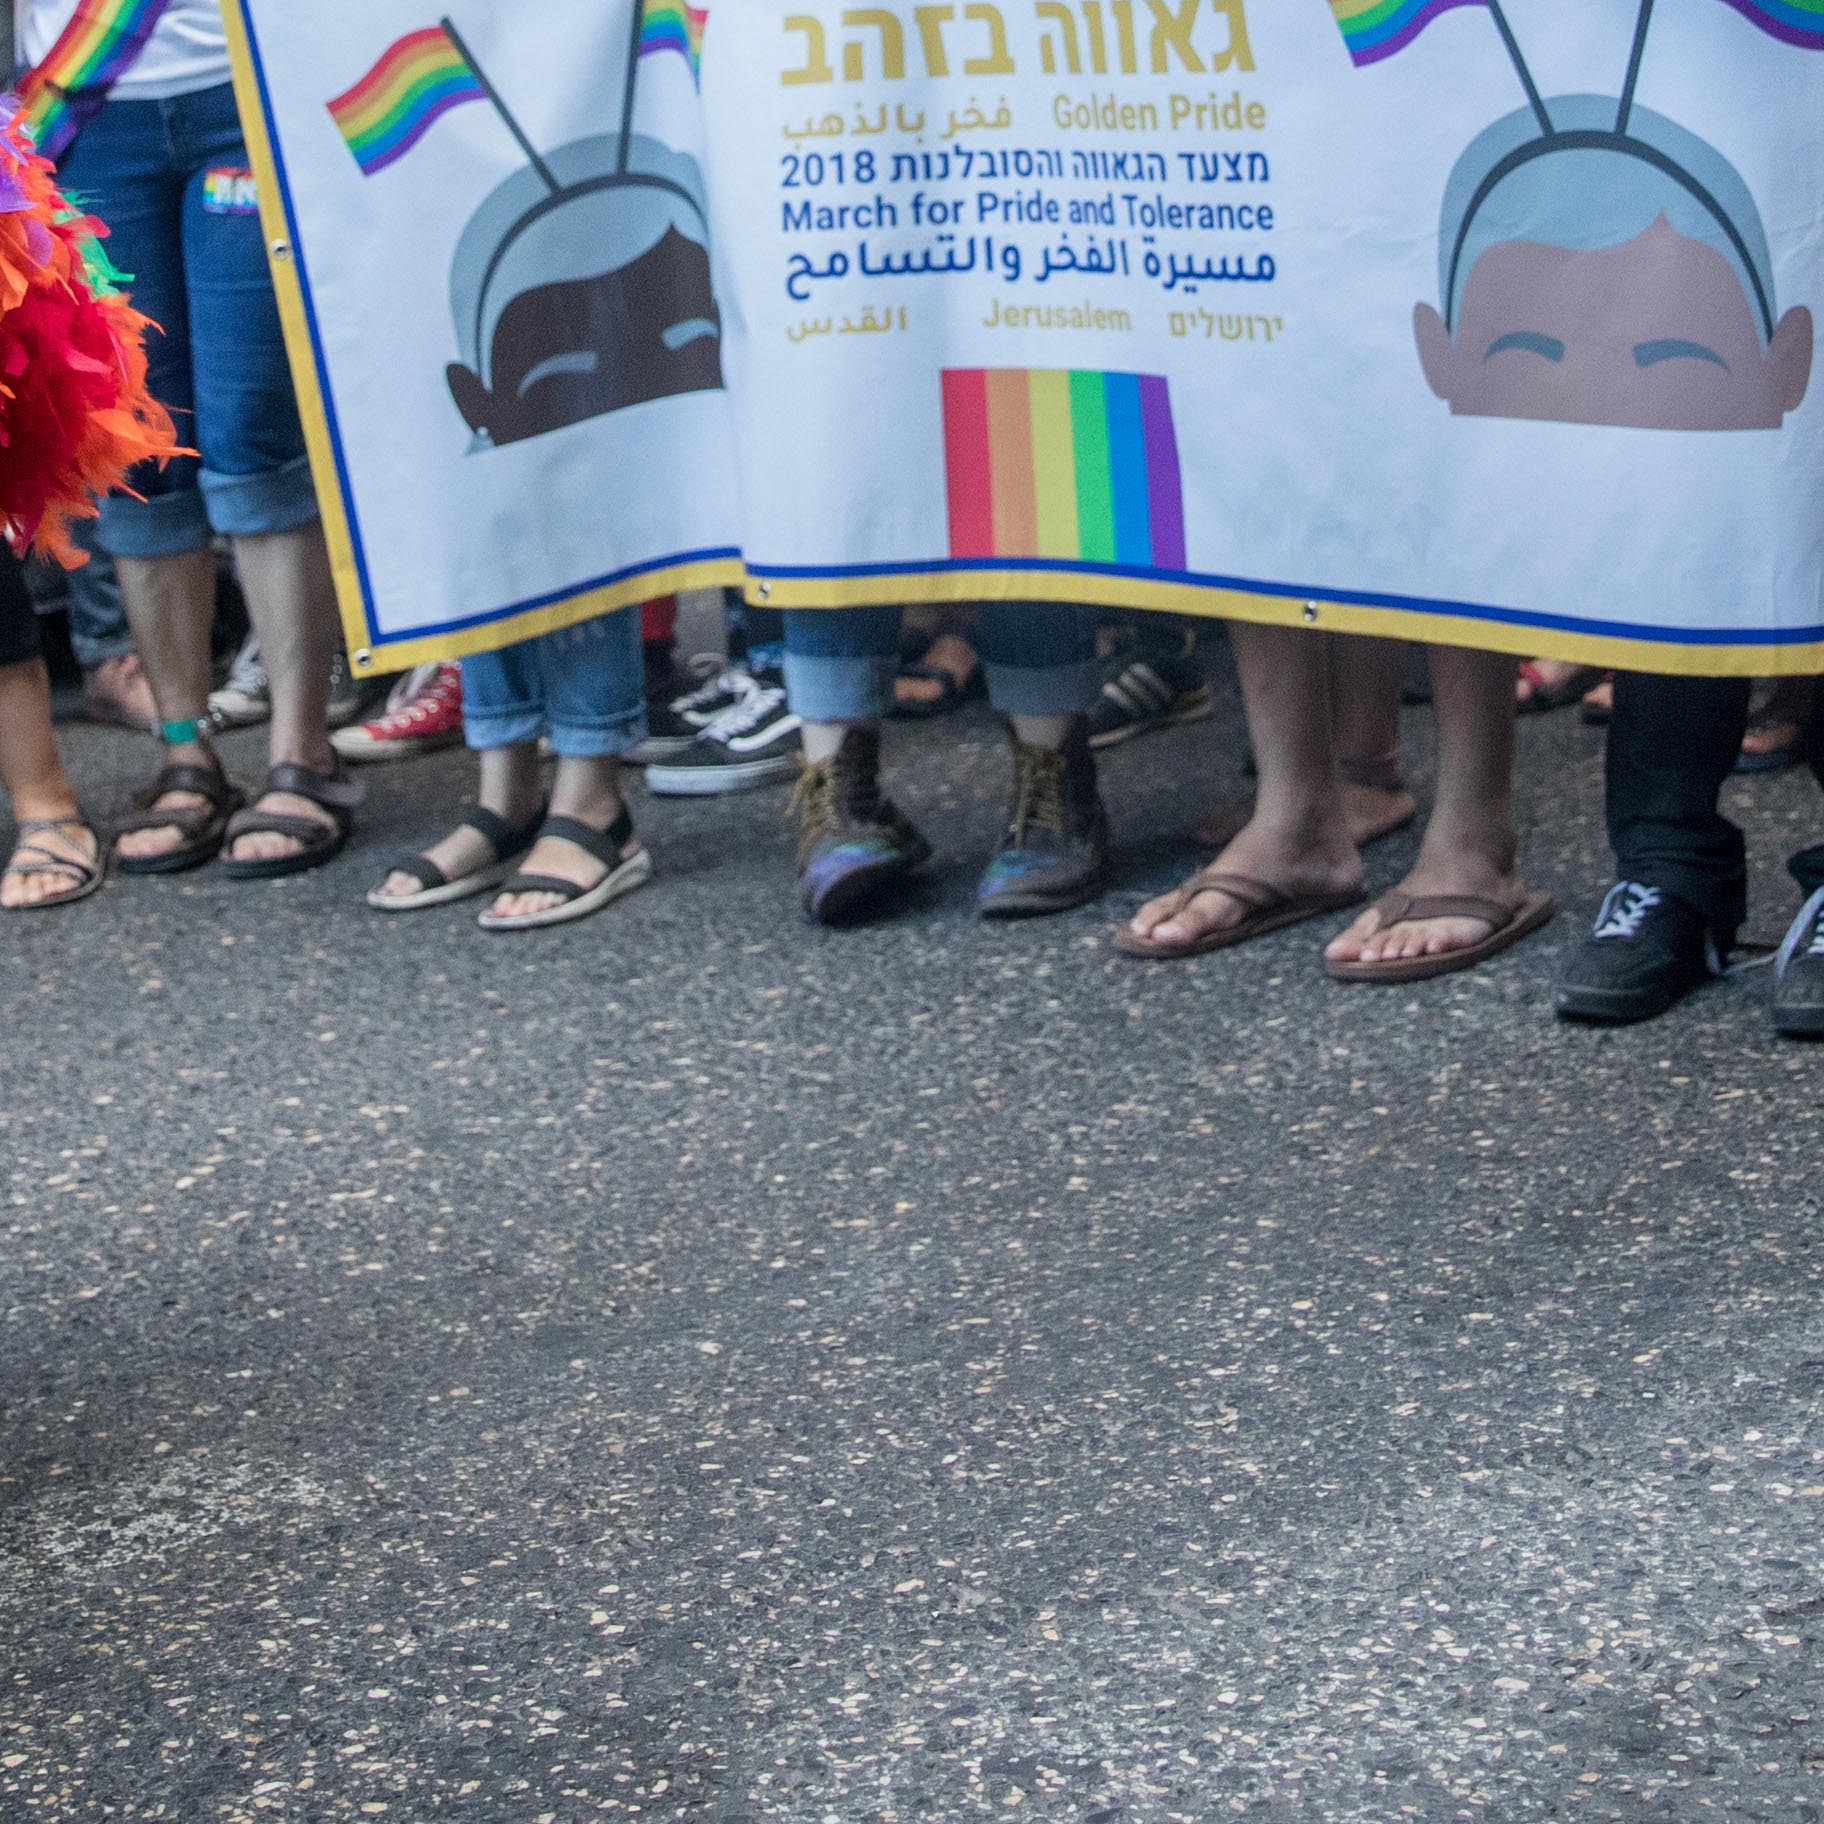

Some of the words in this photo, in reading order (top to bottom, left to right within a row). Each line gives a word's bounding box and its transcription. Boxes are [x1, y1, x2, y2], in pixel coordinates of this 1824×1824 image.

[779, 2, 1016, 87] בזהב
[780, 99, 927, 152] بالذهب
[940, 96, 1013, 141] فخر
[1053, 92, 1159, 132] Golden
[1168, 88, 1267, 131] Pride
[780, 150, 877, 188] 2018
[888, 143, 1064, 185] והסובלנות
[1071, 149, 1167, 184] הגאווה
[1177, 149, 1271, 185] מצעד
[781, 195, 898, 233] March
[910, 192, 966, 227] for
[977, 190, 1060, 225] Pride
[1068, 192, 1115, 227] and
[1126, 193, 1274, 232] Tolerance
[784, 232, 1022, 302] والتسامح
[1034, 232, 1131, 284] الفخر
[1142, 234, 1277, 296] مسيرة
[982, 298, 1134, 334] Jerusalem
[1167, 307, 1284, 344] ירושלים
